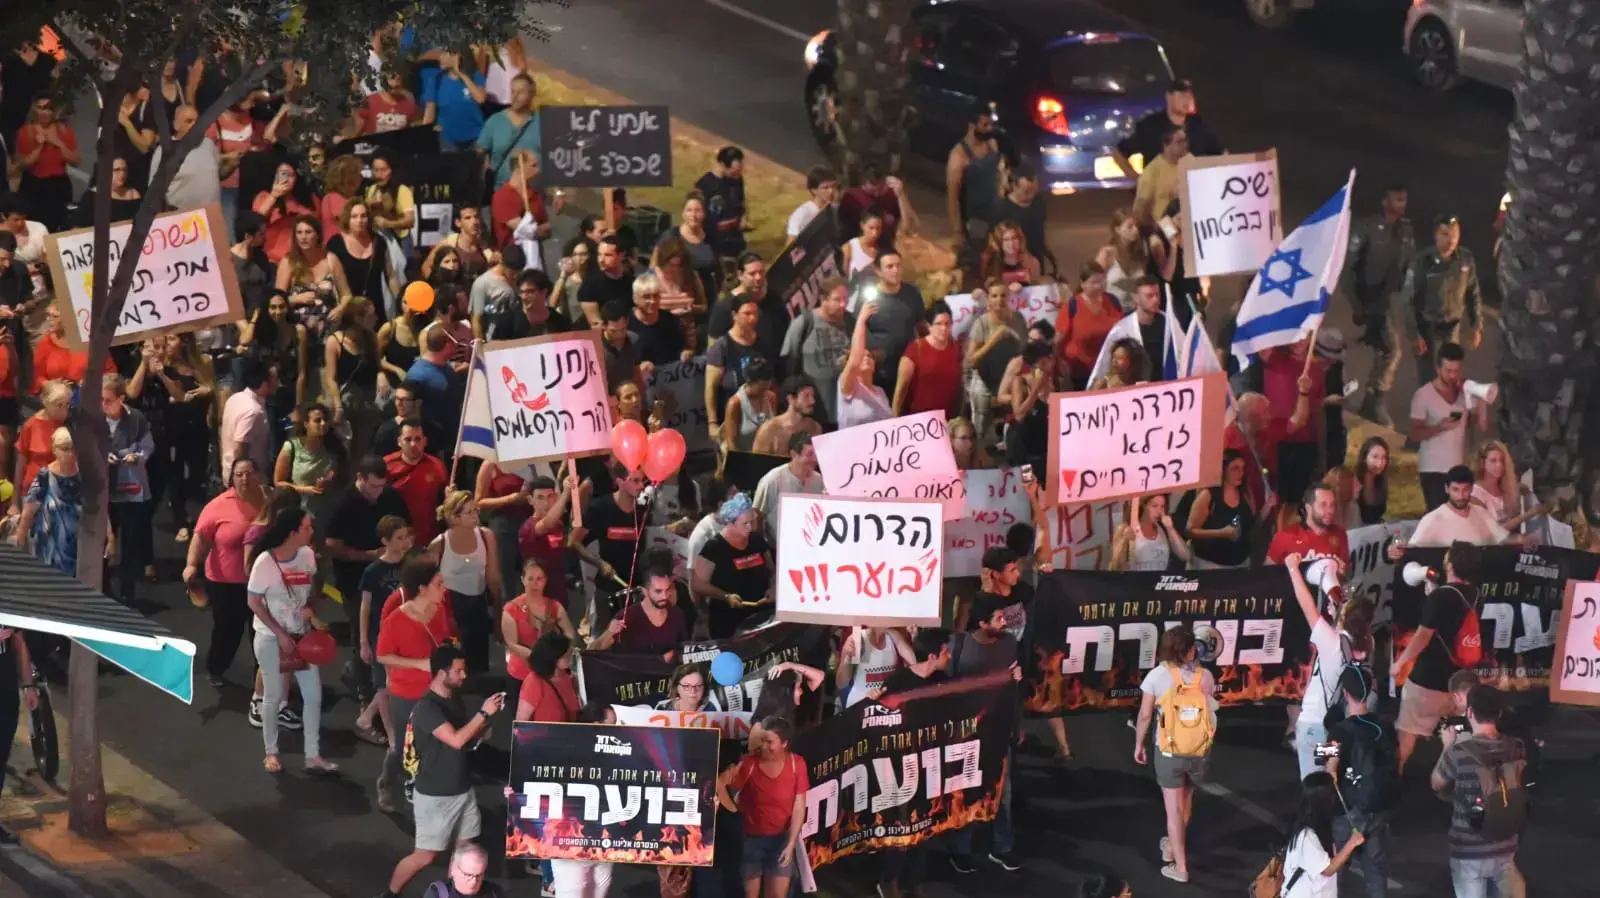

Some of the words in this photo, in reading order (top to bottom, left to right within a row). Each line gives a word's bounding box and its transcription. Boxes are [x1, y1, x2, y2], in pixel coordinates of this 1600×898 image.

[570, 108, 601, 132] לא
[608, 110, 660, 136] אנחנו
[1194, 206, 1262, 260] בביטחון
[166, 256, 210, 286] מתי
[172, 291, 210, 316] פה
[540, 347, 597, 390] אנחנו
[1132, 388, 1195, 421] חרדה
[1061, 402, 1120, 437] קיומית
[1123, 426, 1163, 456] לא
[1167, 423, 1190, 451] זו
[839, 445, 921, 489] שלמות
[1138, 458, 1184, 490] דרך
[818, 512, 932, 549] הדרום
[1079, 602, 1116, 621] אדמתי
[1122, 601, 1139, 618] אם
[1146, 600, 1161, 616] גם
[1213, 598, 1237, 616] ארץ
[1245, 597, 1257, 615] לי
[1263, 597, 1283, 616] אין
[918, 724, 937, 747] ארץ
[944, 723, 954, 738] לי
[961, 717, 978, 739] אין
[843, 745, 854, 761] אם
[857, 738, 868, 757] גם
[532, 765, 564, 779] אדמתי
[570, 766, 584, 779] אם
[589, 767, 602, 780] גם
[643, 769, 662, 784] ארץ
[668, 769, 677, 783] לי
[682, 771, 697, 785] אין
[813, 753, 840, 780] אדמתי
[801, 739, 983, 840] בוערת
[520, 781, 702, 826] בוערת
